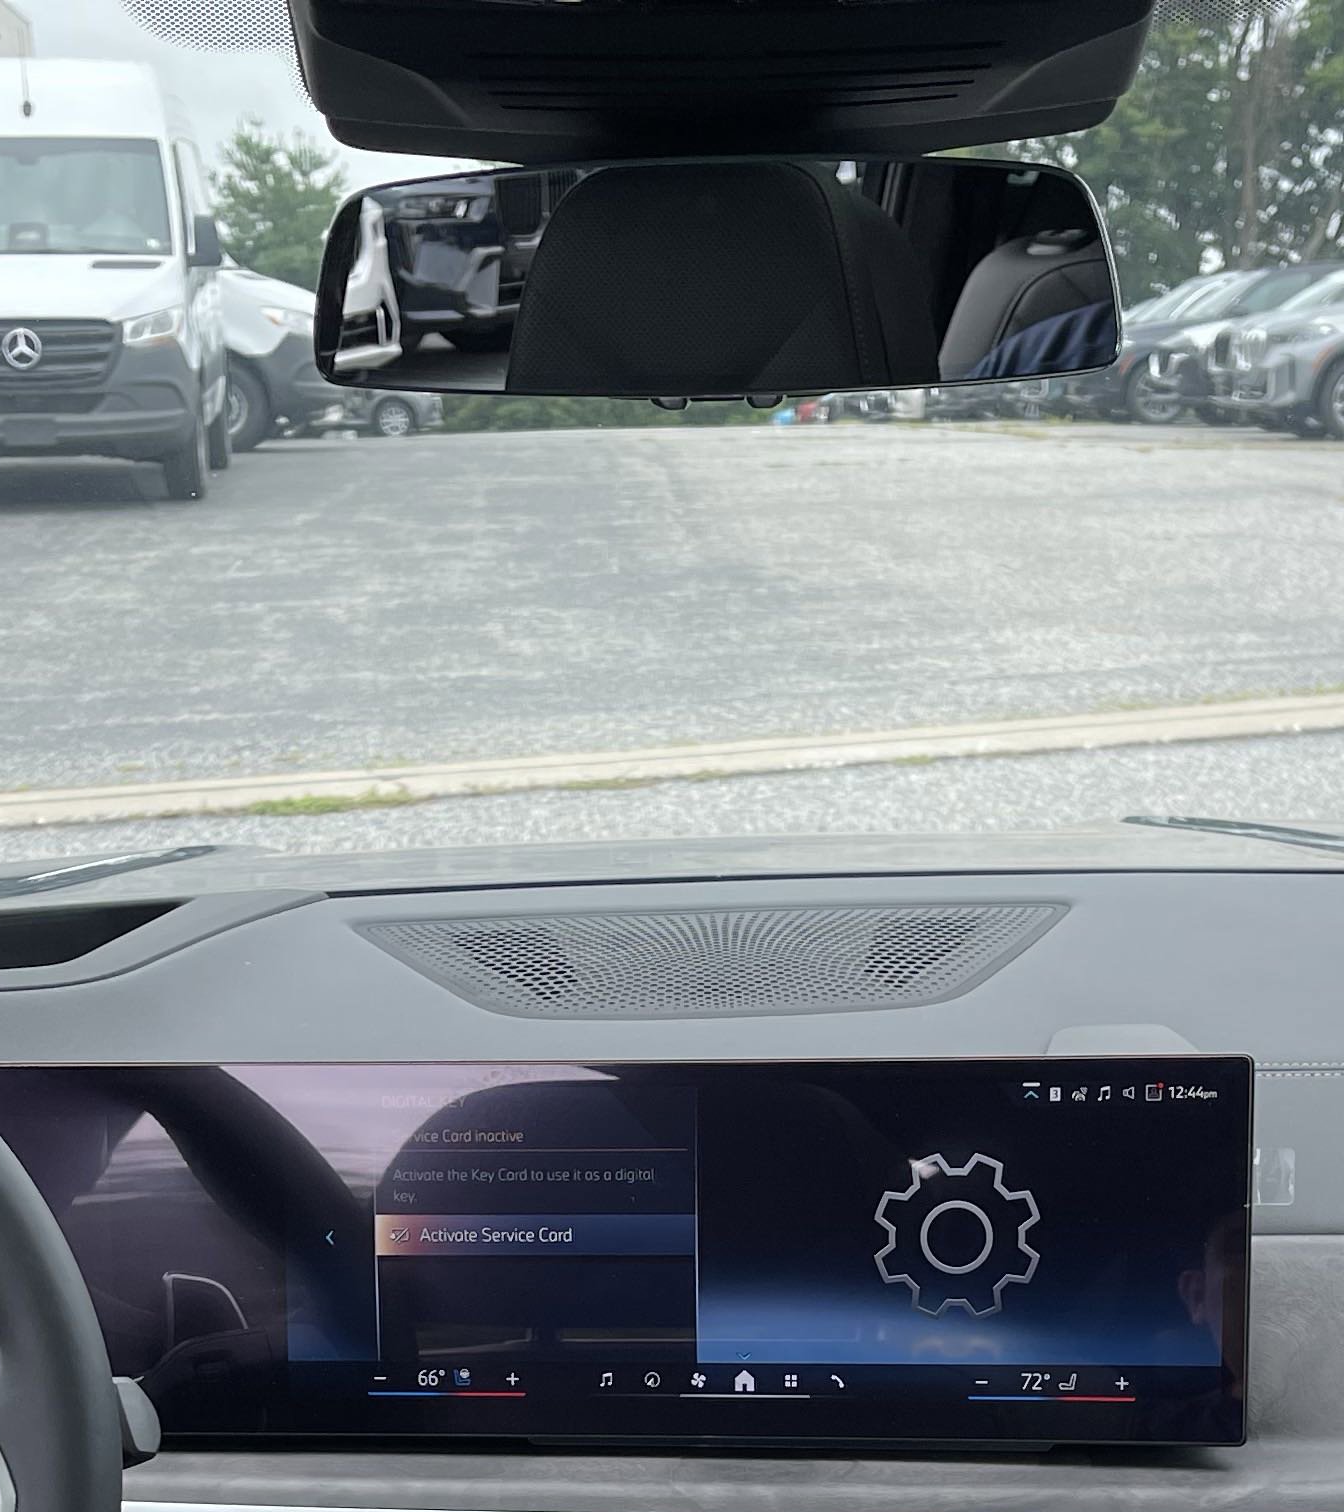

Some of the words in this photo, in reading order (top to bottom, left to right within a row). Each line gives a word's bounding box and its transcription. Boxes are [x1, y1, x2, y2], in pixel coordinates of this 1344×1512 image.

[442, 1129, 471, 1142] Card
[475, 1129, 524, 1142] inactive
[393, 1169, 443, 1181] Activate
[447, 1168, 468, 1181] the
[471, 1169, 494, 1184] Key
[498, 1168, 527, 1181] Card
[531, 1170, 544, 1181] to
[547, 1172, 570, 1181] use
[573, 1168, 581, 1181] it
[584, 1172, 600, 1181] as
[604, 1172, 612, 1181] a
[615, 1168, 655, 1183] digital
[393, 1190, 418, 1204] key.
[420, 1228, 477, 1243] Activate
[482, 1228, 534, 1242] Service
[538, 1228, 573, 1242] Card
